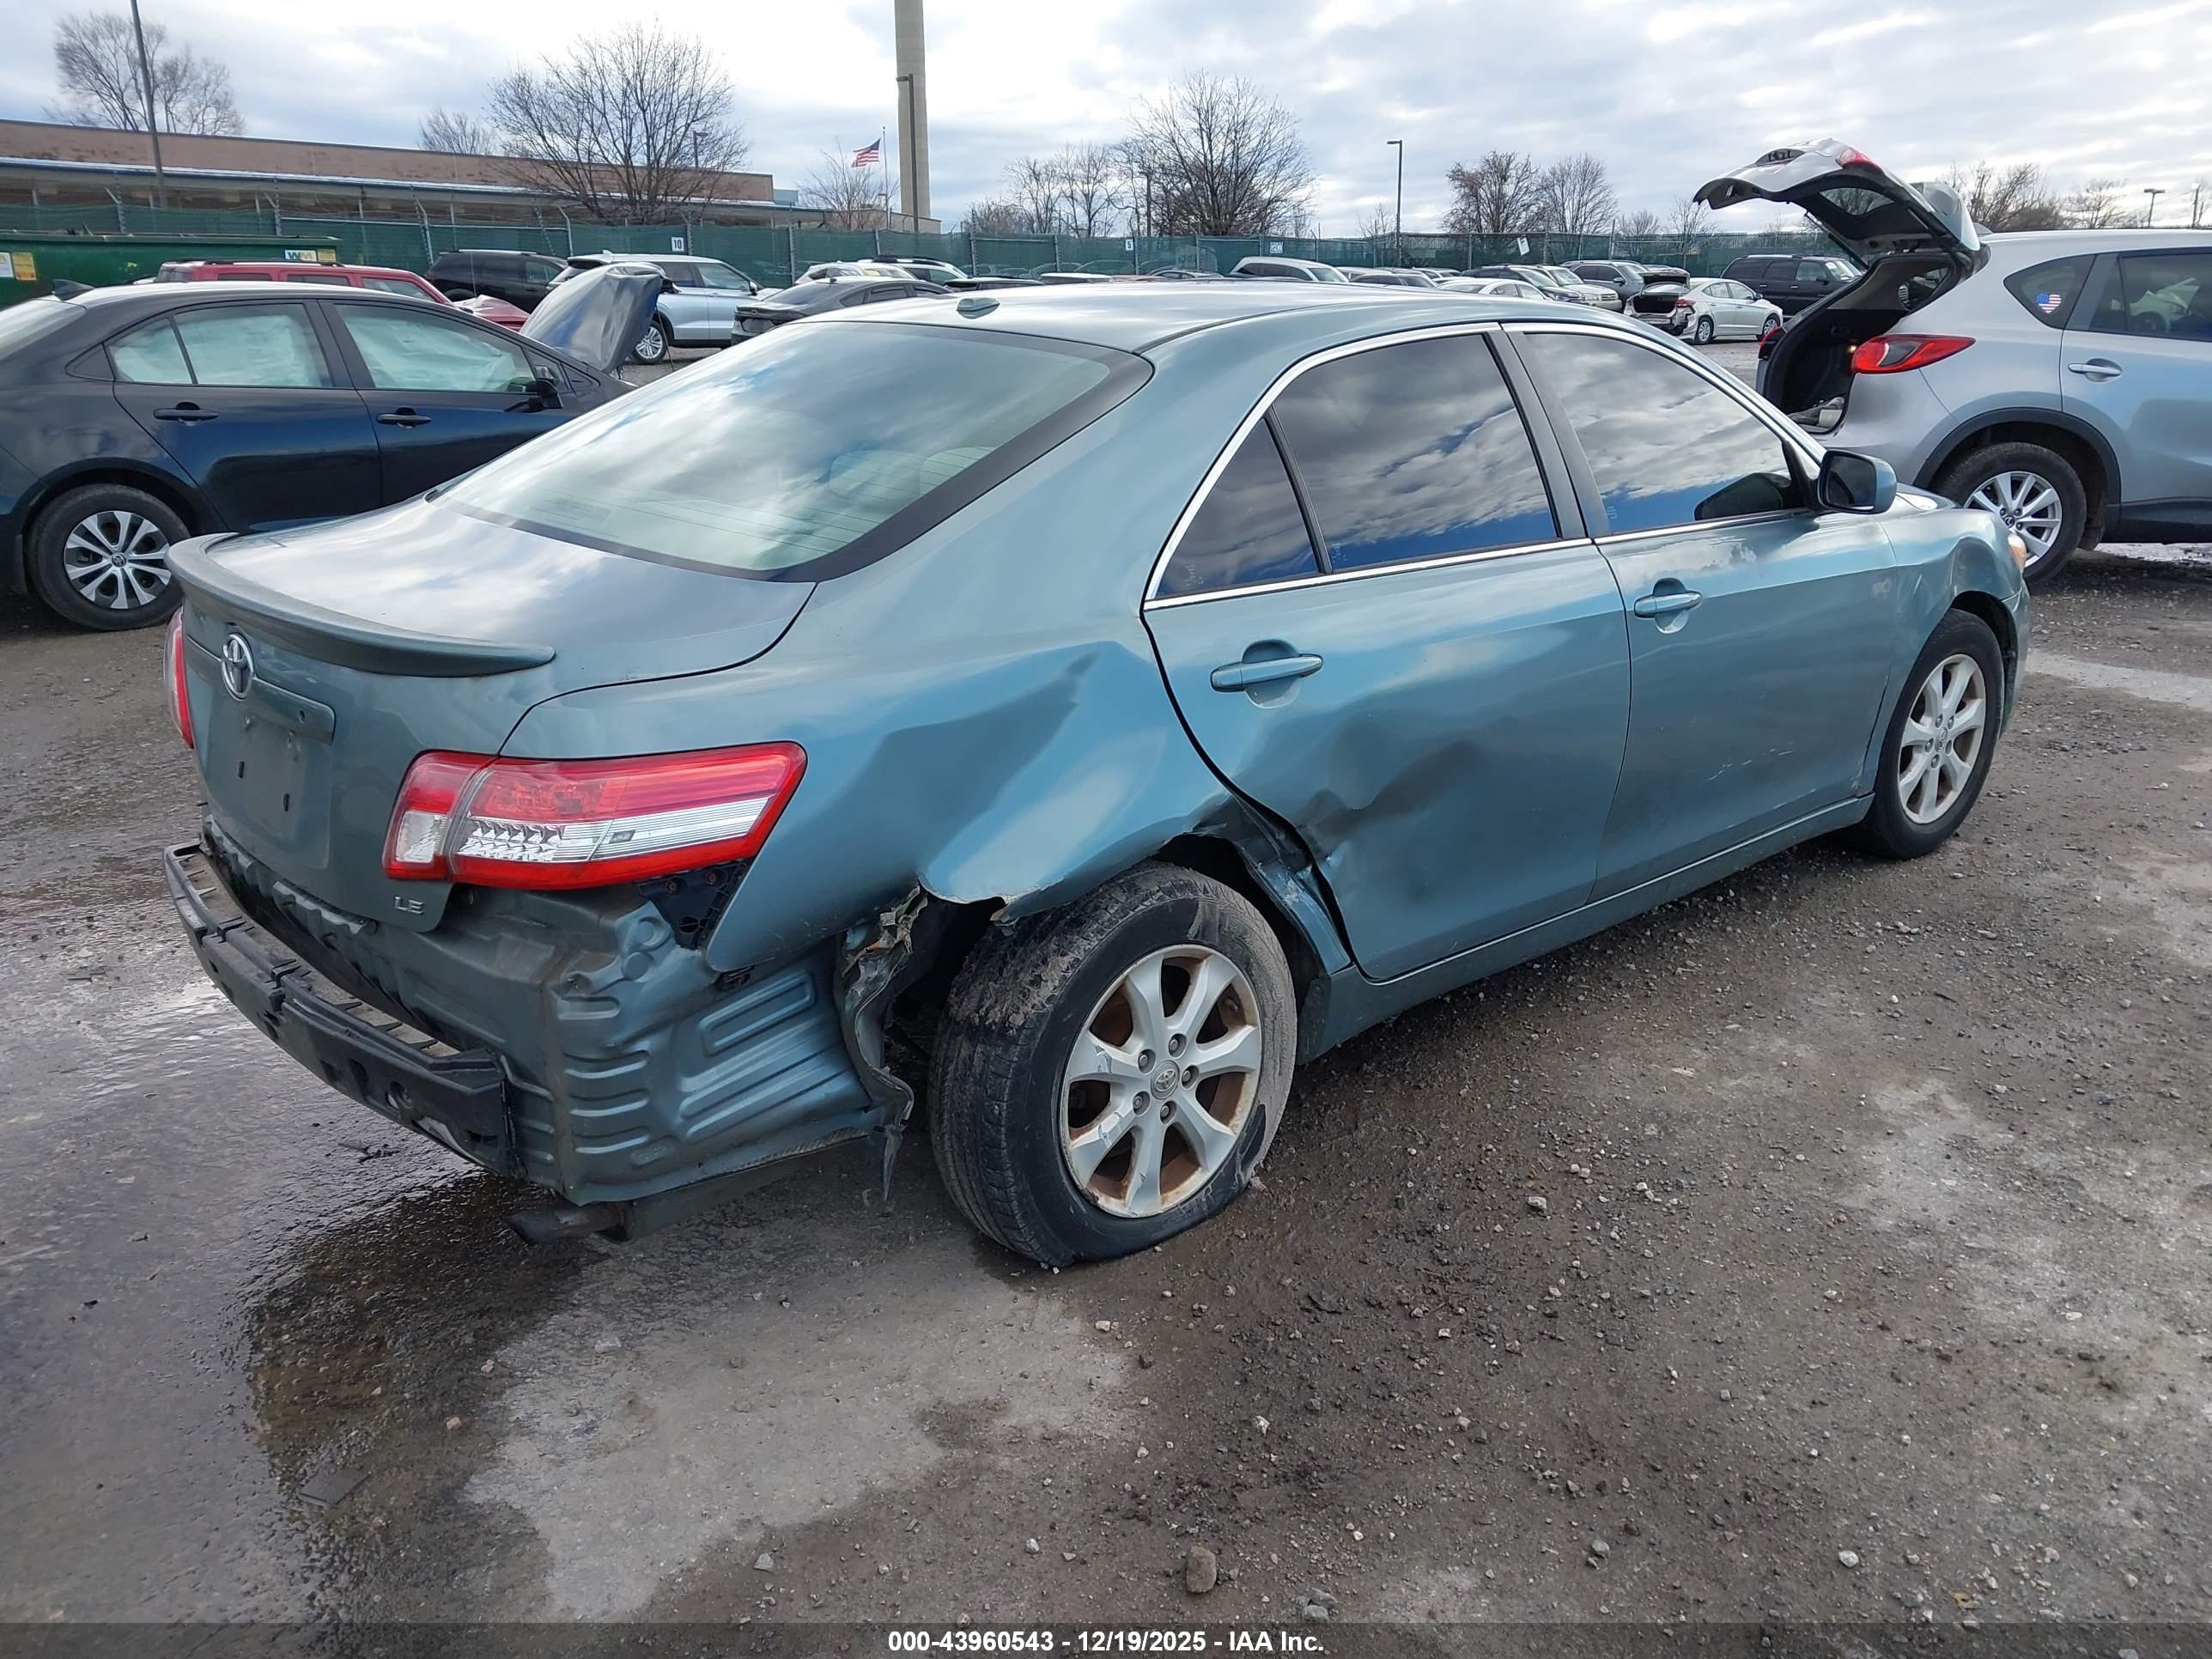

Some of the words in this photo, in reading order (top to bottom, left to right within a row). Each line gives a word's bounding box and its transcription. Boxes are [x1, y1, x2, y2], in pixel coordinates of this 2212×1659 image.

[673, 239, 683, 249] 10
[1127, 240, 1132, 249] 5
[394, 896, 424, 915] LE
